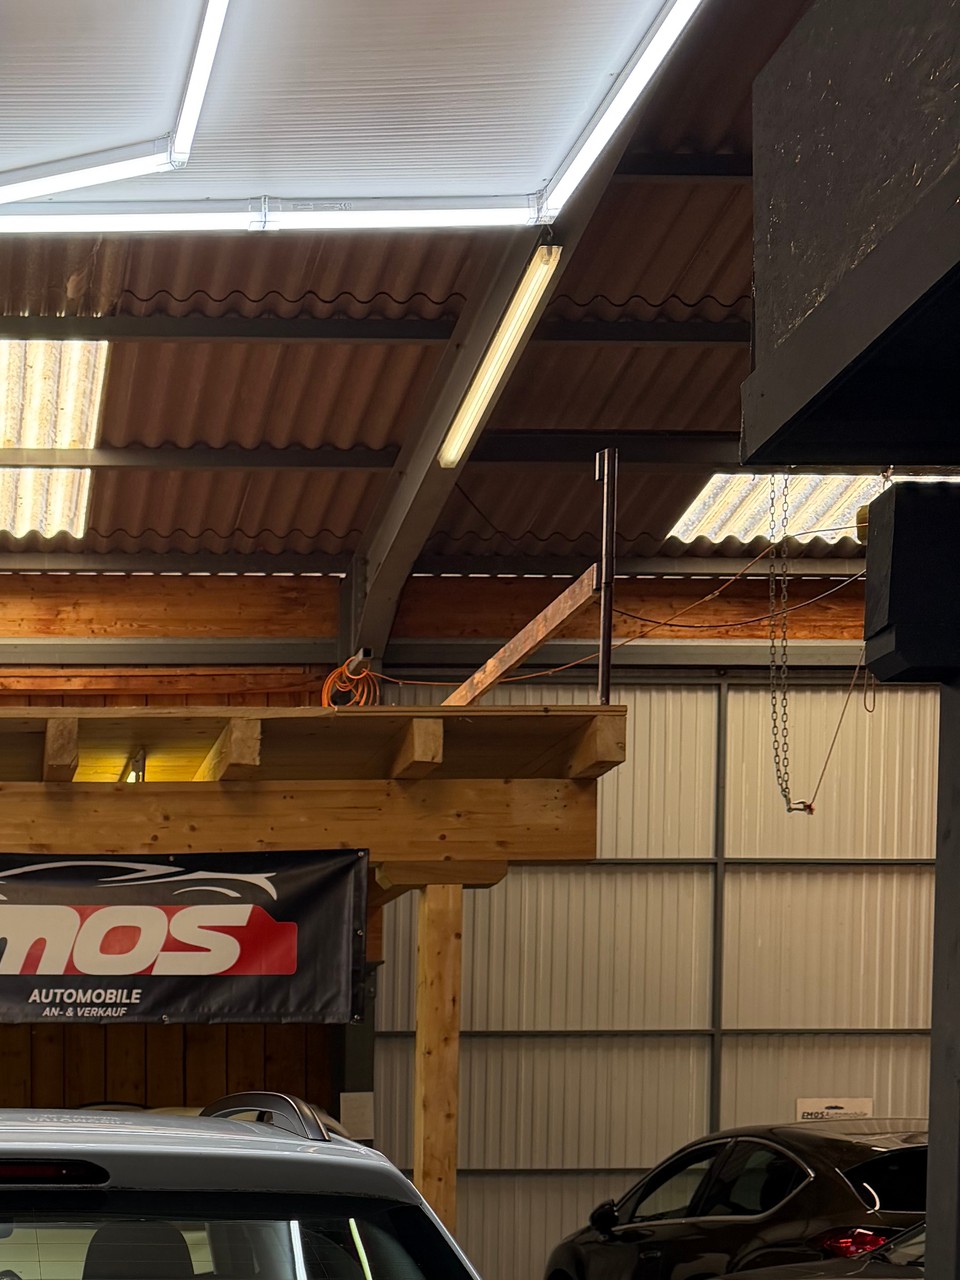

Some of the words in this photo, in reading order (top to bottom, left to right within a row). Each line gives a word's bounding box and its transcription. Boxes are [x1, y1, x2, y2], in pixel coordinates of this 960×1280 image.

[28, 988, 142, 1004] AUTOMOBILE
[42, 1007, 64, 1017] AN-
[65, 1007, 74, 1017] &
[77, 1007, 128, 1017] VERKAUF
